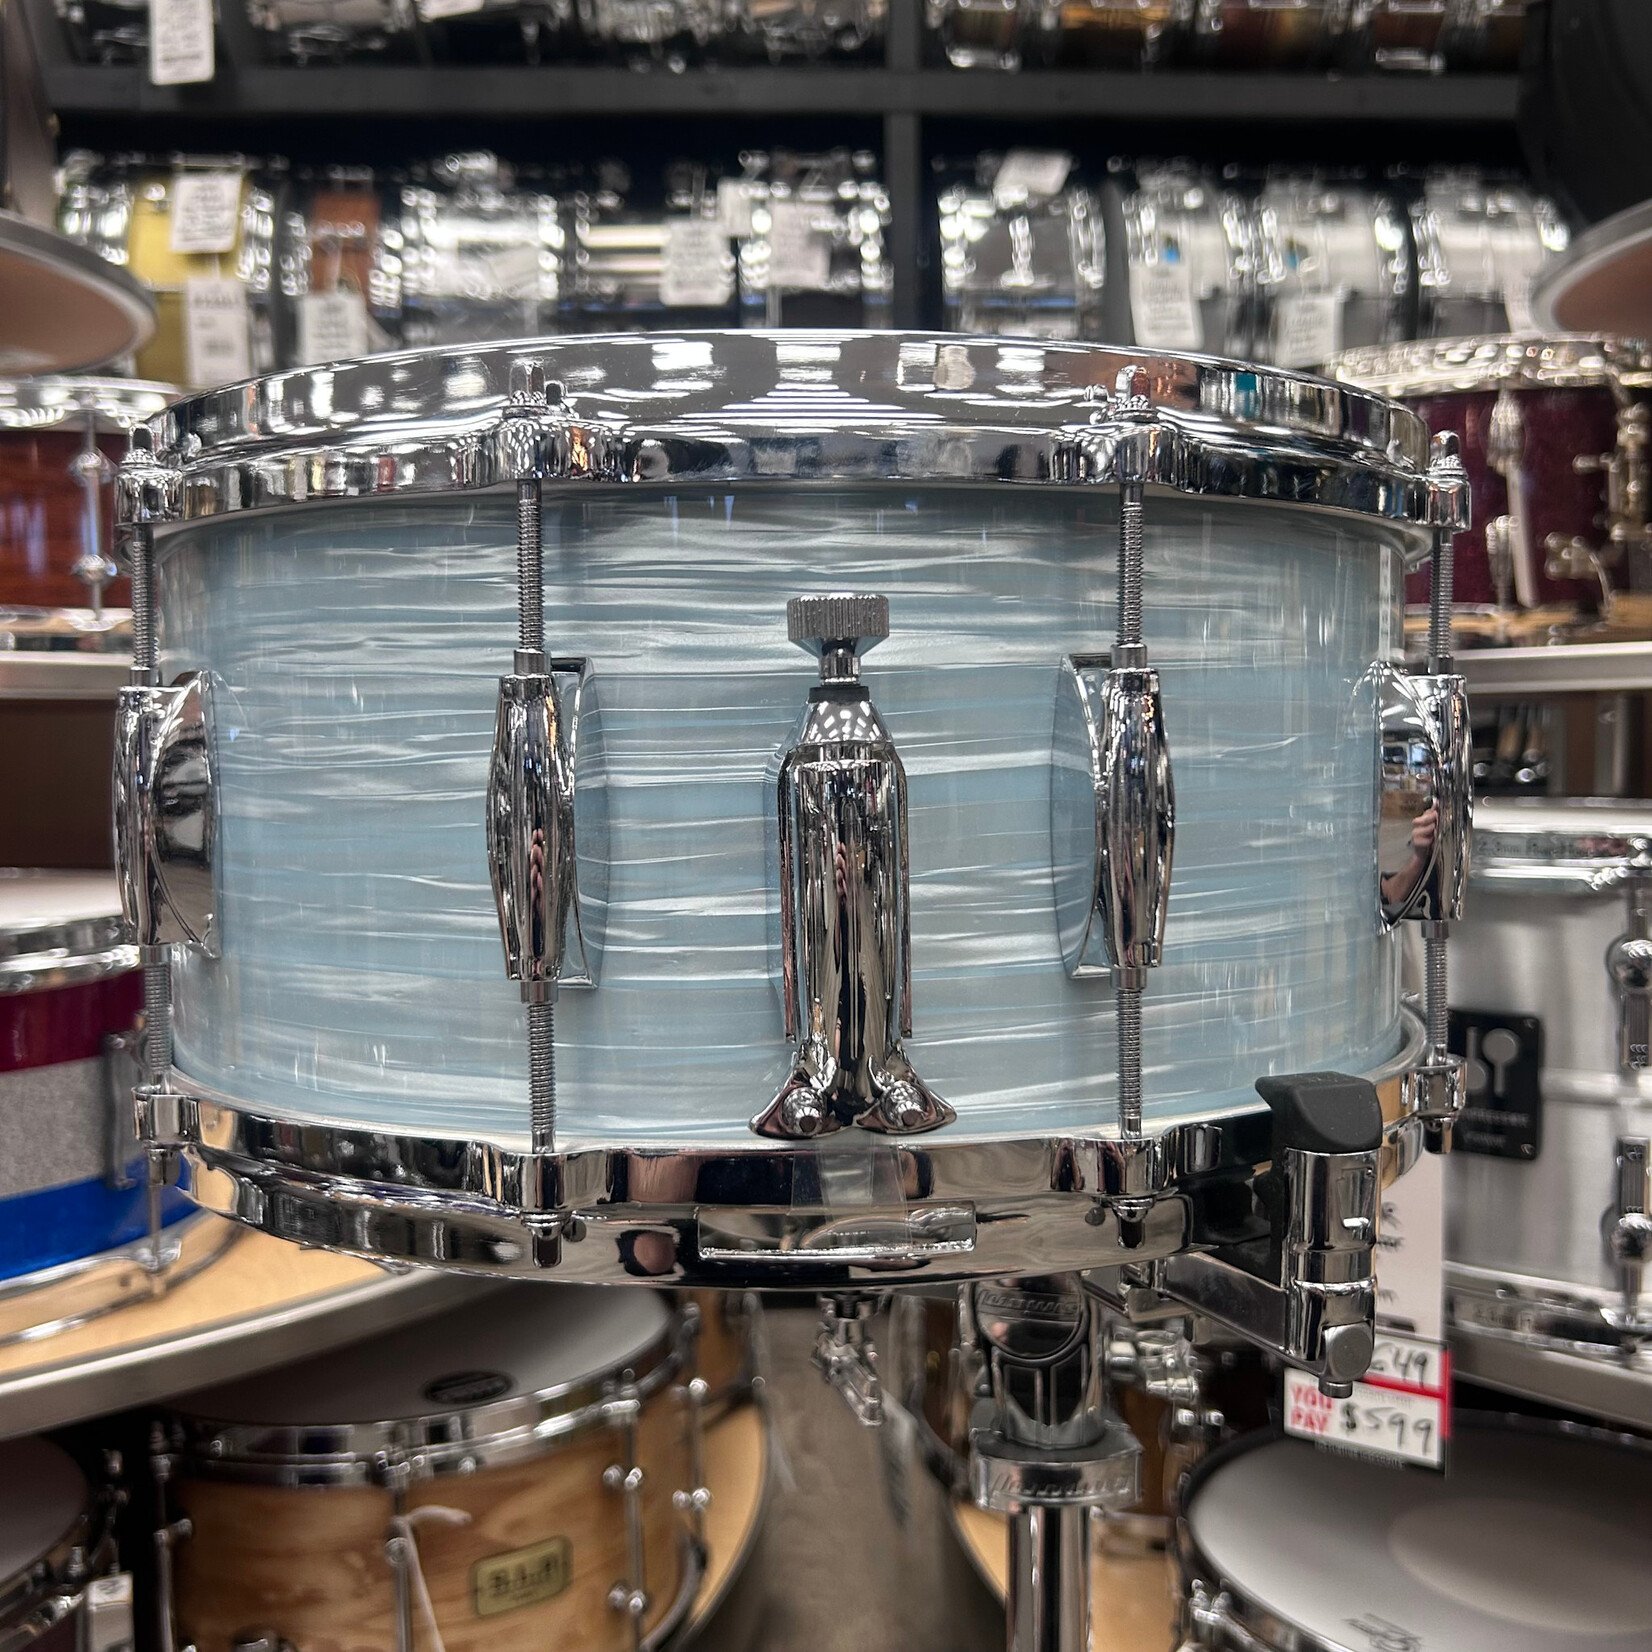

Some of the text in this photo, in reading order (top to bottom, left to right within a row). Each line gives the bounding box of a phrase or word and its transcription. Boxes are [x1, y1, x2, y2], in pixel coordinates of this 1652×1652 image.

[1291, 1383, 1334, 1411] YOU
[1290, 1407, 1331, 1434] PAY
[1339, 1400, 1436, 1457] $599
